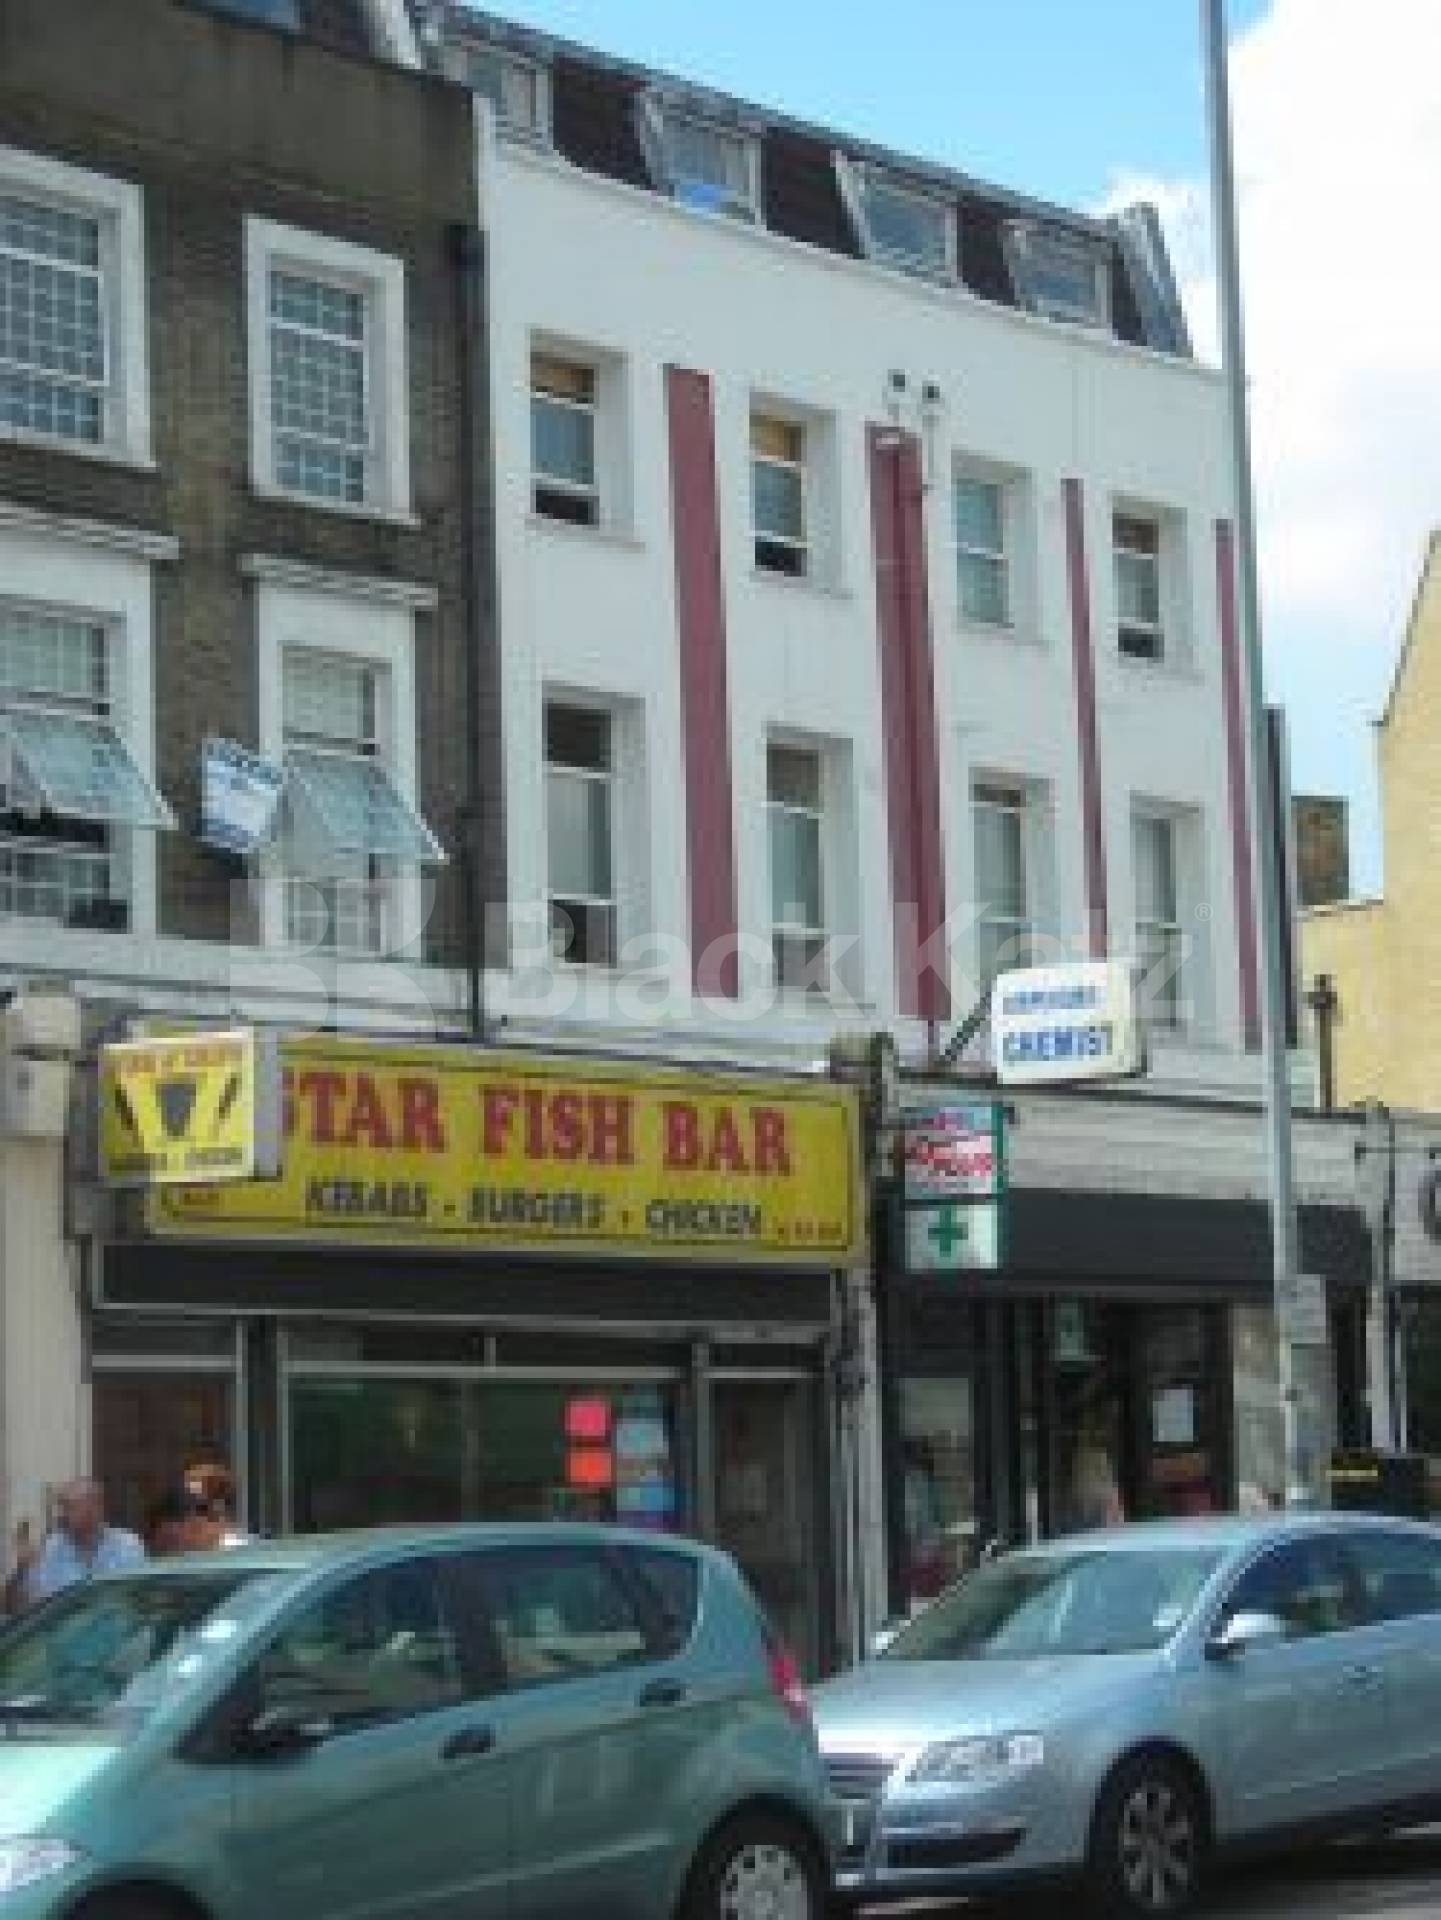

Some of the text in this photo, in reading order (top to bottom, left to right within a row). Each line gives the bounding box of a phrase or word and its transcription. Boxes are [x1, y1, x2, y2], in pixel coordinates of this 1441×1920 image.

[479, 1084, 634, 1165] FISH
[662, 1101, 790, 1176] BAR
[305, 1177, 428, 1217] KEBABS
[467, 1187, 600, 1230] BURGERS
[645, 1199, 761, 1236] CHICKEN
